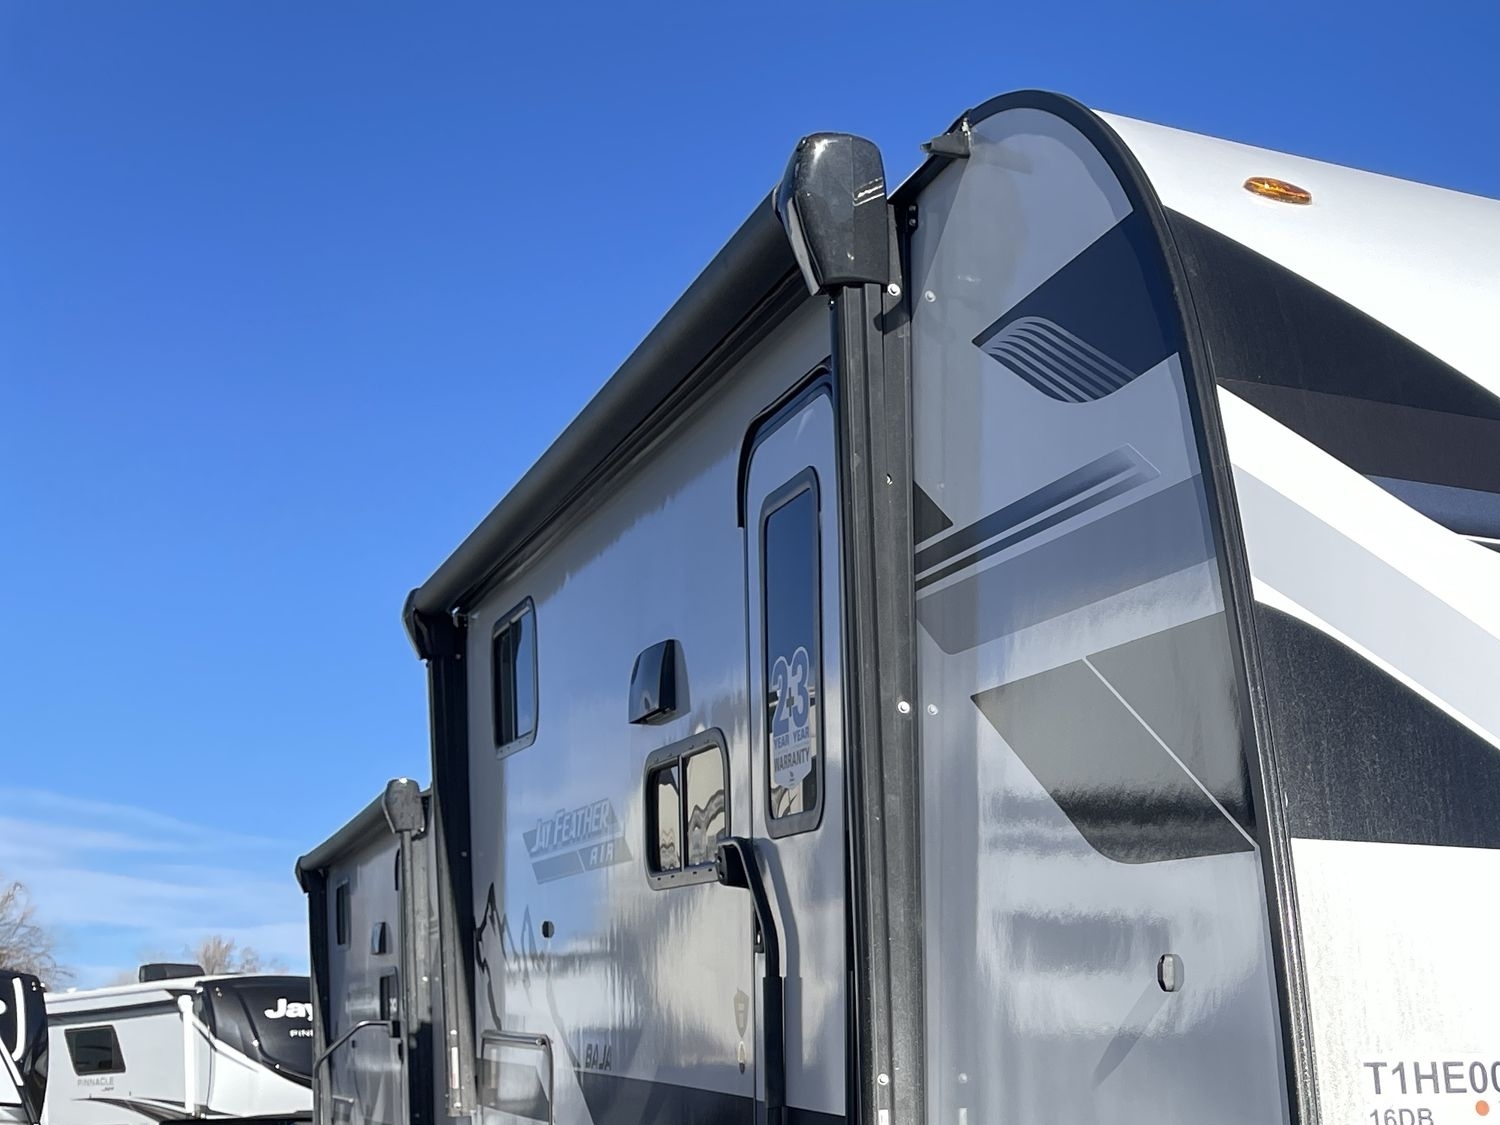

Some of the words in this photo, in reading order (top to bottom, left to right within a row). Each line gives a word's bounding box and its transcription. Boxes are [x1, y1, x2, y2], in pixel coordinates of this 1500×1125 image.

[774, 734, 790, 750] YEAR
[793, 726, 810, 743] YEAR
[774, 747, 810, 772] WARRANTY
[590, 841, 615, 866] AIR
[585, 1043, 612, 1071] BAJA
[77, 1077, 115, 1088] PINNACLE
